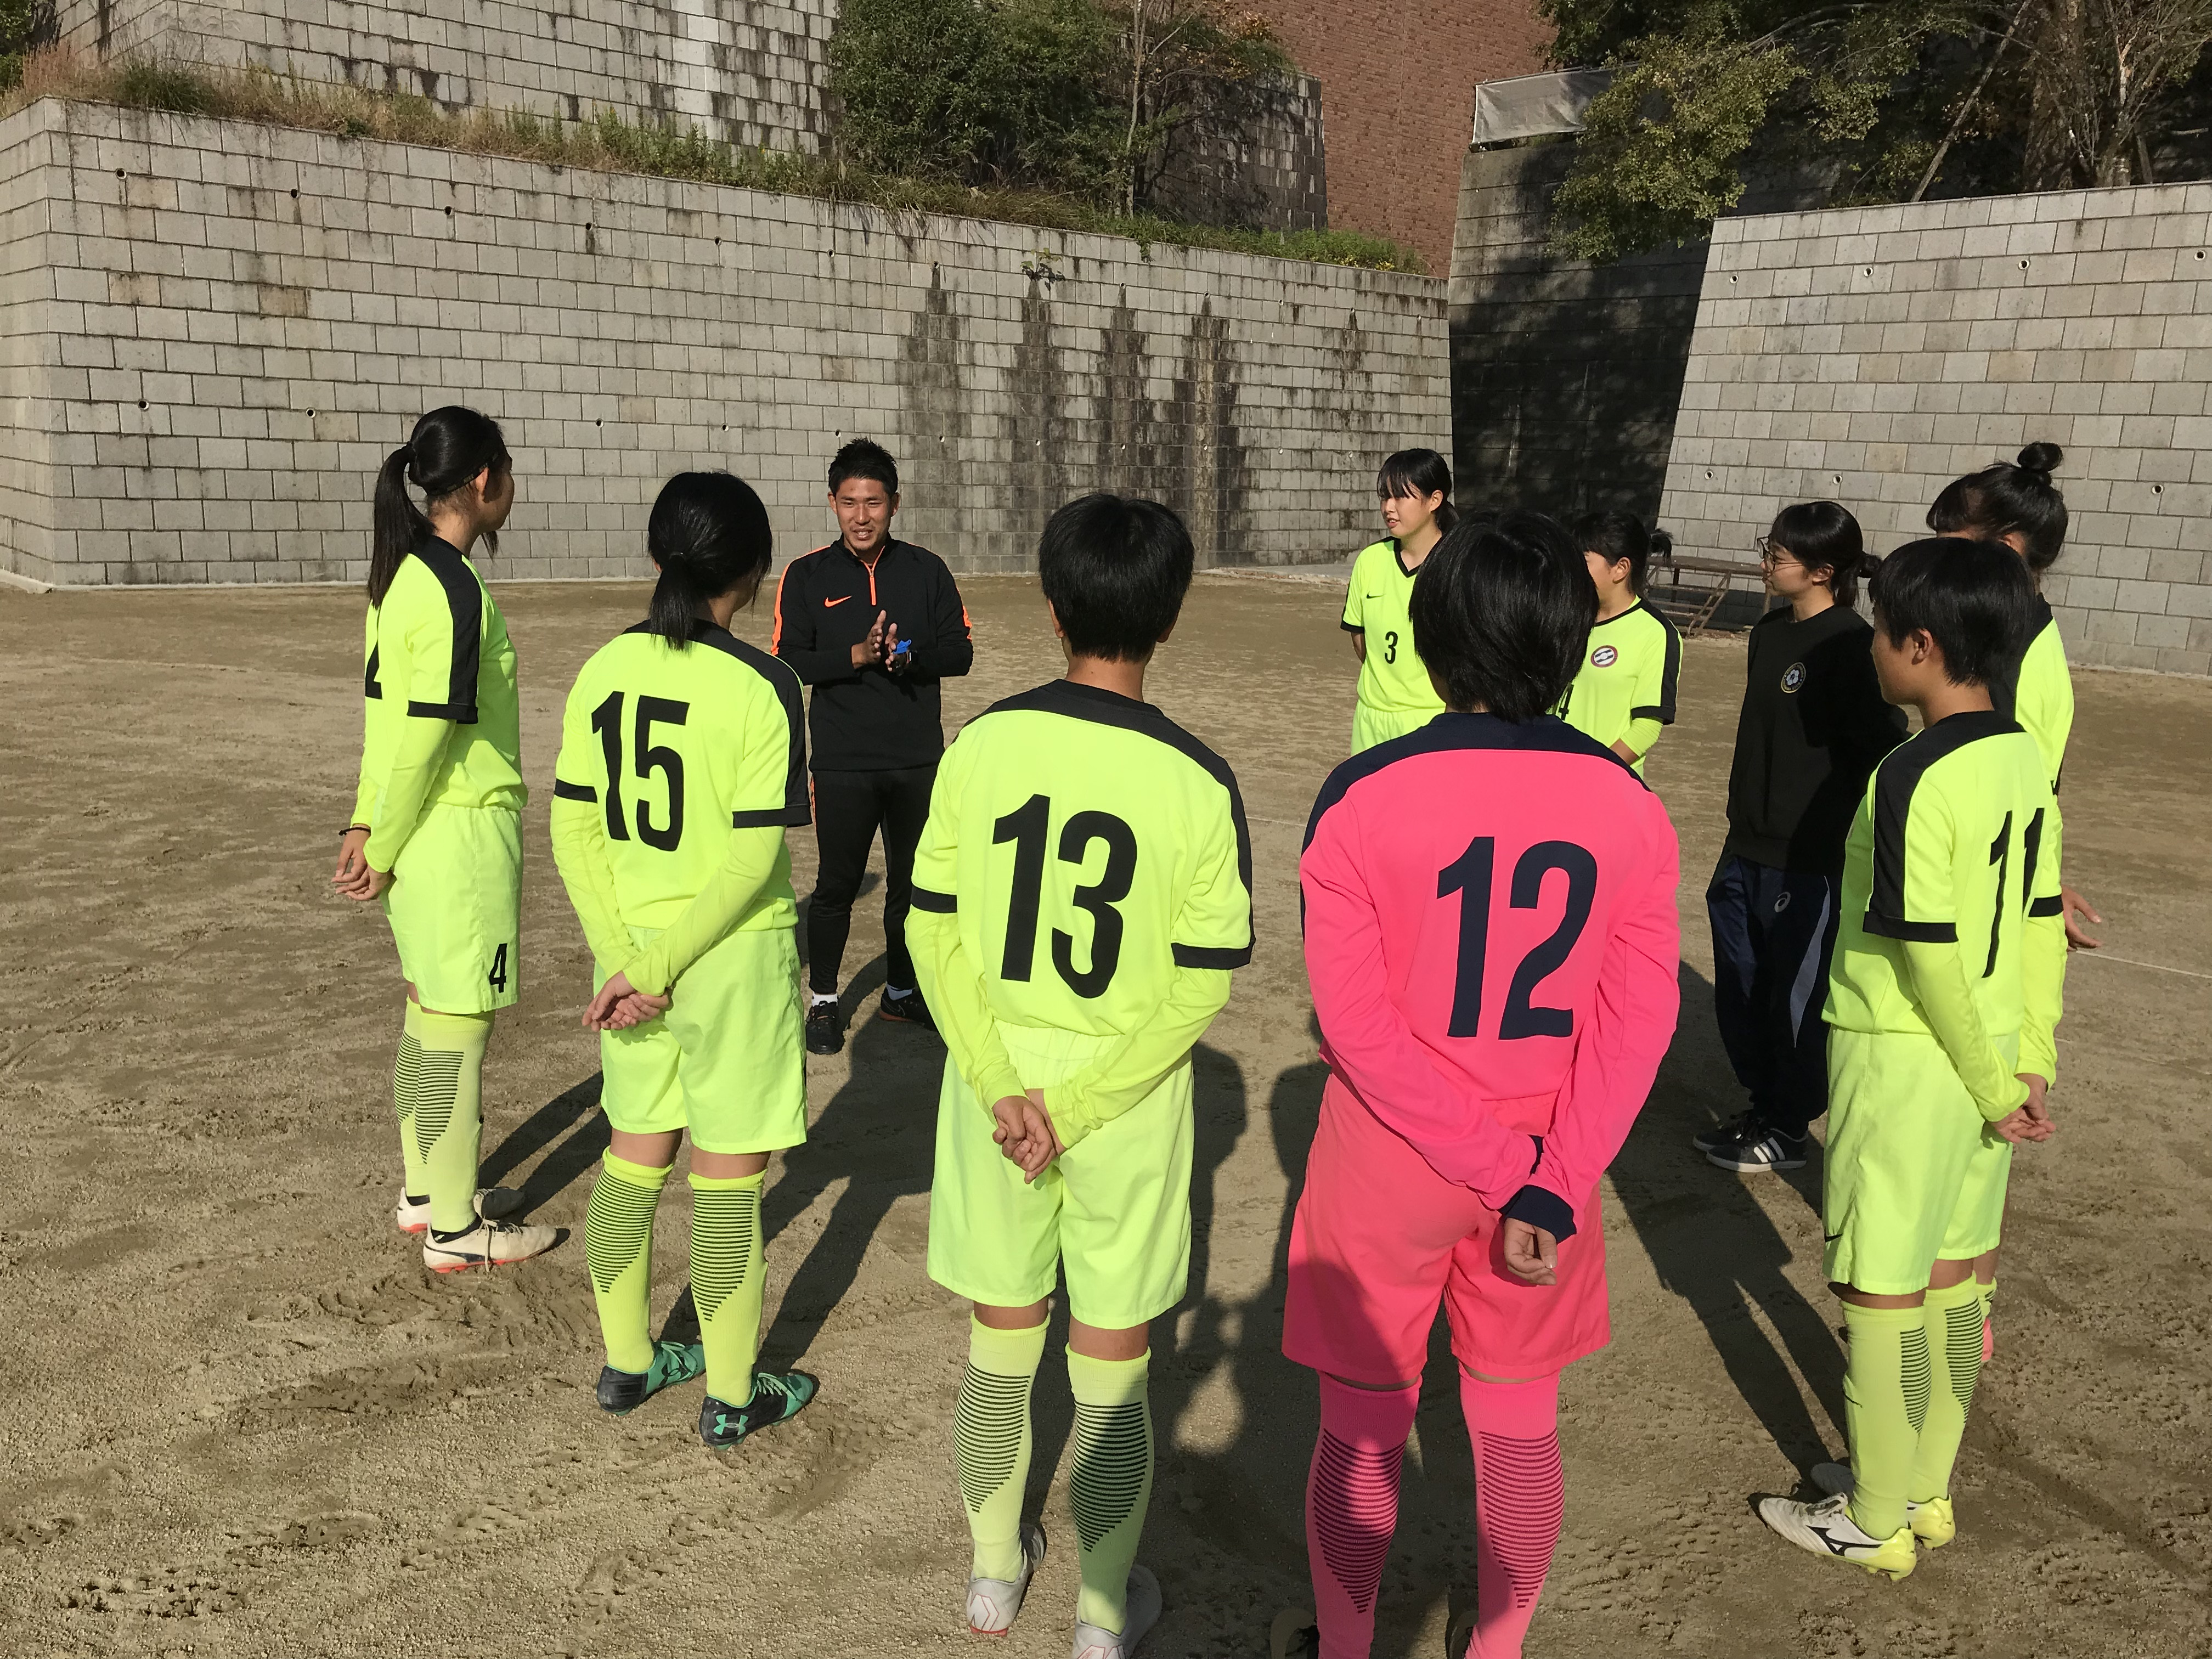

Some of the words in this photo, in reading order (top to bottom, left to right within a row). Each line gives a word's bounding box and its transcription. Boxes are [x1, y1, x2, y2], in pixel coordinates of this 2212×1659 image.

[1384, 631, 1398, 664] 3
[591, 691, 690, 852] 15
[488, 943, 508, 994] 4
[992, 793, 1138, 999] 13
[1436, 836, 1598, 1040] 12
[1981, 807, 2045, 978] 11
